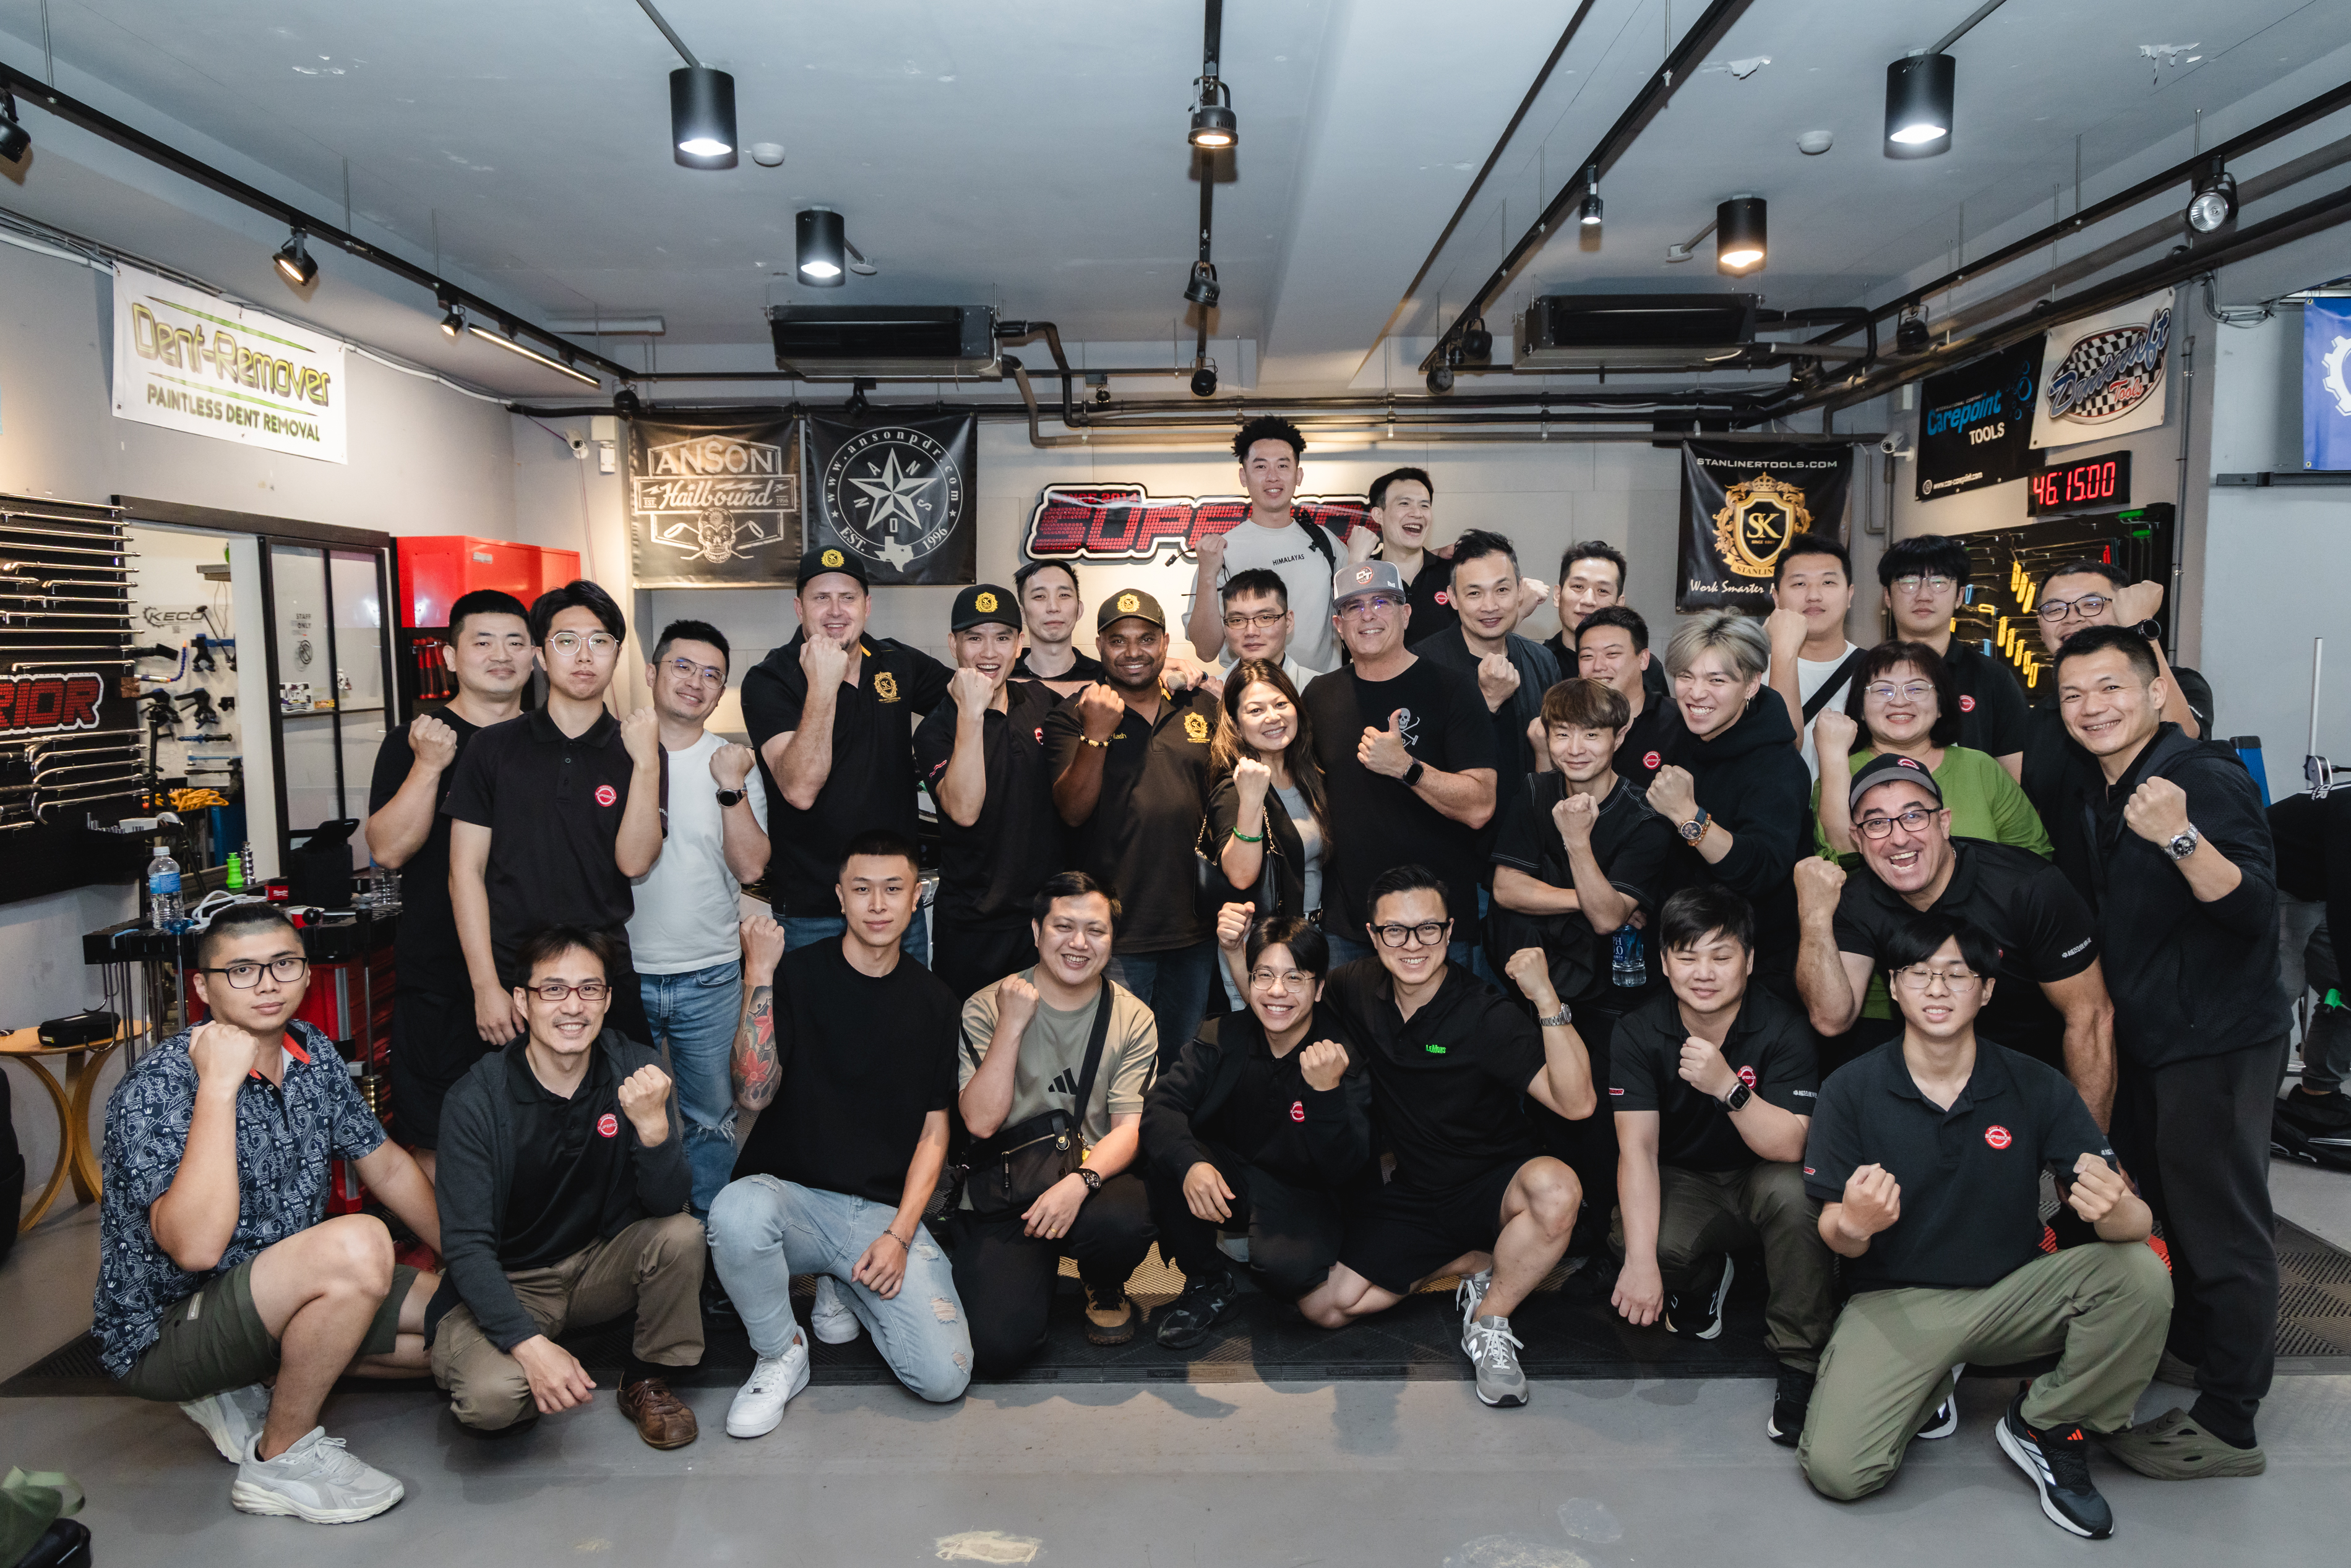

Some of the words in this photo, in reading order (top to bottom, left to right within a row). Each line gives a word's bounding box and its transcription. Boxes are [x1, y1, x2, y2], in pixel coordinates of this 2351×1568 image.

[132, 302, 330, 407] Dent-Remover
[2048, 308, 2170, 418] Dentcraft
[2109, 377, 2144, 402] Tools
[147, 383, 222, 421] PAINTLESS
[226, 403, 260, 429] DENT
[264, 412, 320, 442] REMOVAL
[1927, 389, 2002, 435] Carepoint
[1969, 422, 2005, 445] TOOLS
[655, 441, 773, 474] ANSON
[827, 431, 959, 503] www.ansonpdr.com
[1697, 458, 1837, 468] STANLINERTOOLS.COM
[659, 480, 774, 510] Hailbound
[1101, 493, 1138, 503] 2014
[840, 526, 866, 552] EST.
[922, 527, 948, 551] 1996
[1273, 554, 1305, 565] HIMALAYAS
[1690, 579, 1718, 593] Work
[1721, 580, 1764, 593] Smarter
